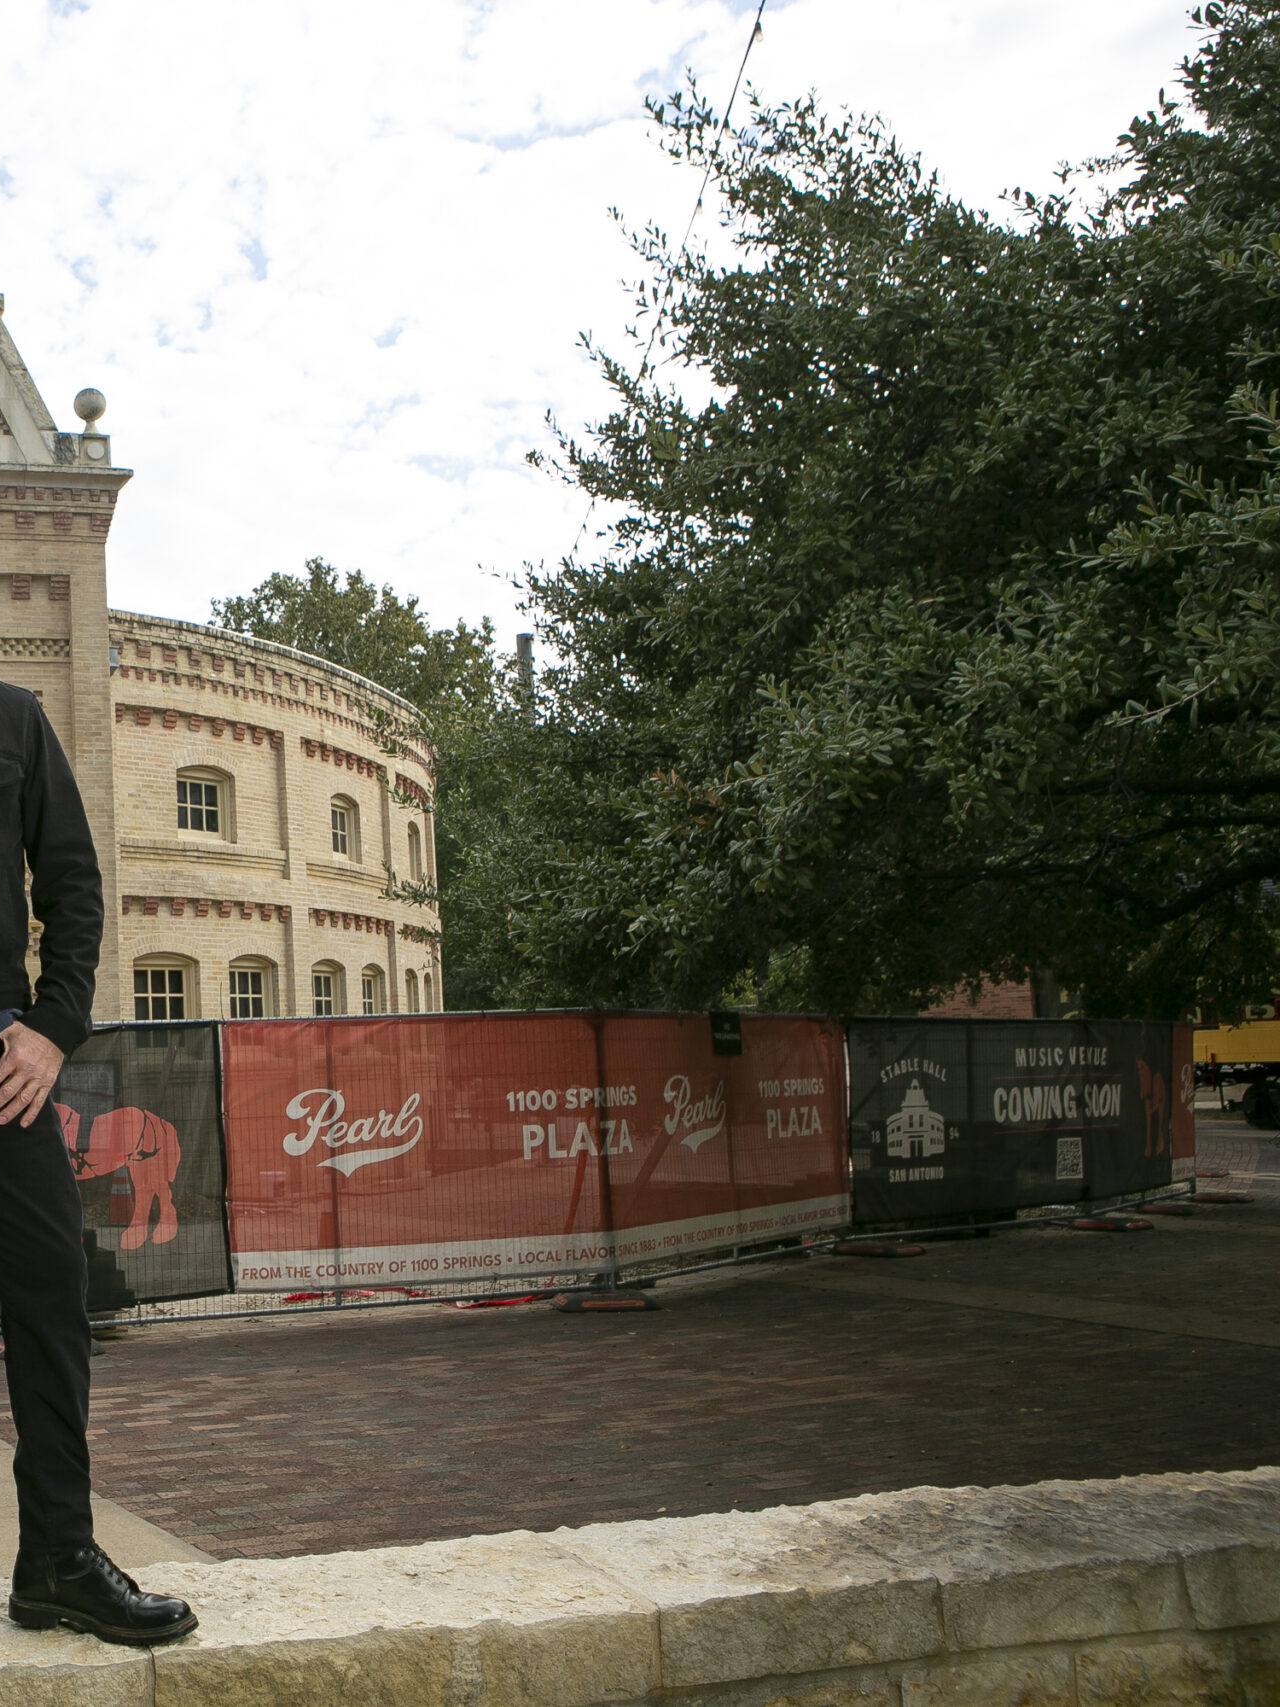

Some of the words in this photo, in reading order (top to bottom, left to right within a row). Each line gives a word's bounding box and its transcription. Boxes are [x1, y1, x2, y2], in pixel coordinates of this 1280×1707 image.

[880, 1057, 920, 1083] STABLE
[923, 1059, 947, 1082] HALL
[1015, 1047, 1064, 1067] MUSIC
[506, 1089, 557, 1112] 1100
[564, 1085, 637, 1110] SPRINGS
[758, 1079, 780, 1098] 1100
[783, 1077, 825, 1097] SPRINGS
[663, 1074, 727, 1136] Pearl
[993, 1084, 1078, 1123] COMING
[1084, 1084, 1122, 1118] SOON
[282, 1088, 424, 1158] Pearl
[766, 1105, 823, 1139] PLAZA
[522, 1119, 634, 1160] PLAZA
[889, 1168, 907, 1183] SAN
[908, 1166, 944, 1182] ANTONIO
[242, 1267, 281, 1280] FROM
[285, 1266, 311, 1278] THE
[316, 1262, 384, 1277] COUNTRY
[389, 1261, 407, 1274] OF
[411, 1259, 438, 1272] 1100
[443, 1255, 502, 1270] SPRINGS
[518, 1250, 562, 1264] LOCAL
[566, 1246, 616, 1261] FLAVOR
[618, 1241, 638, 1257] SINCE
